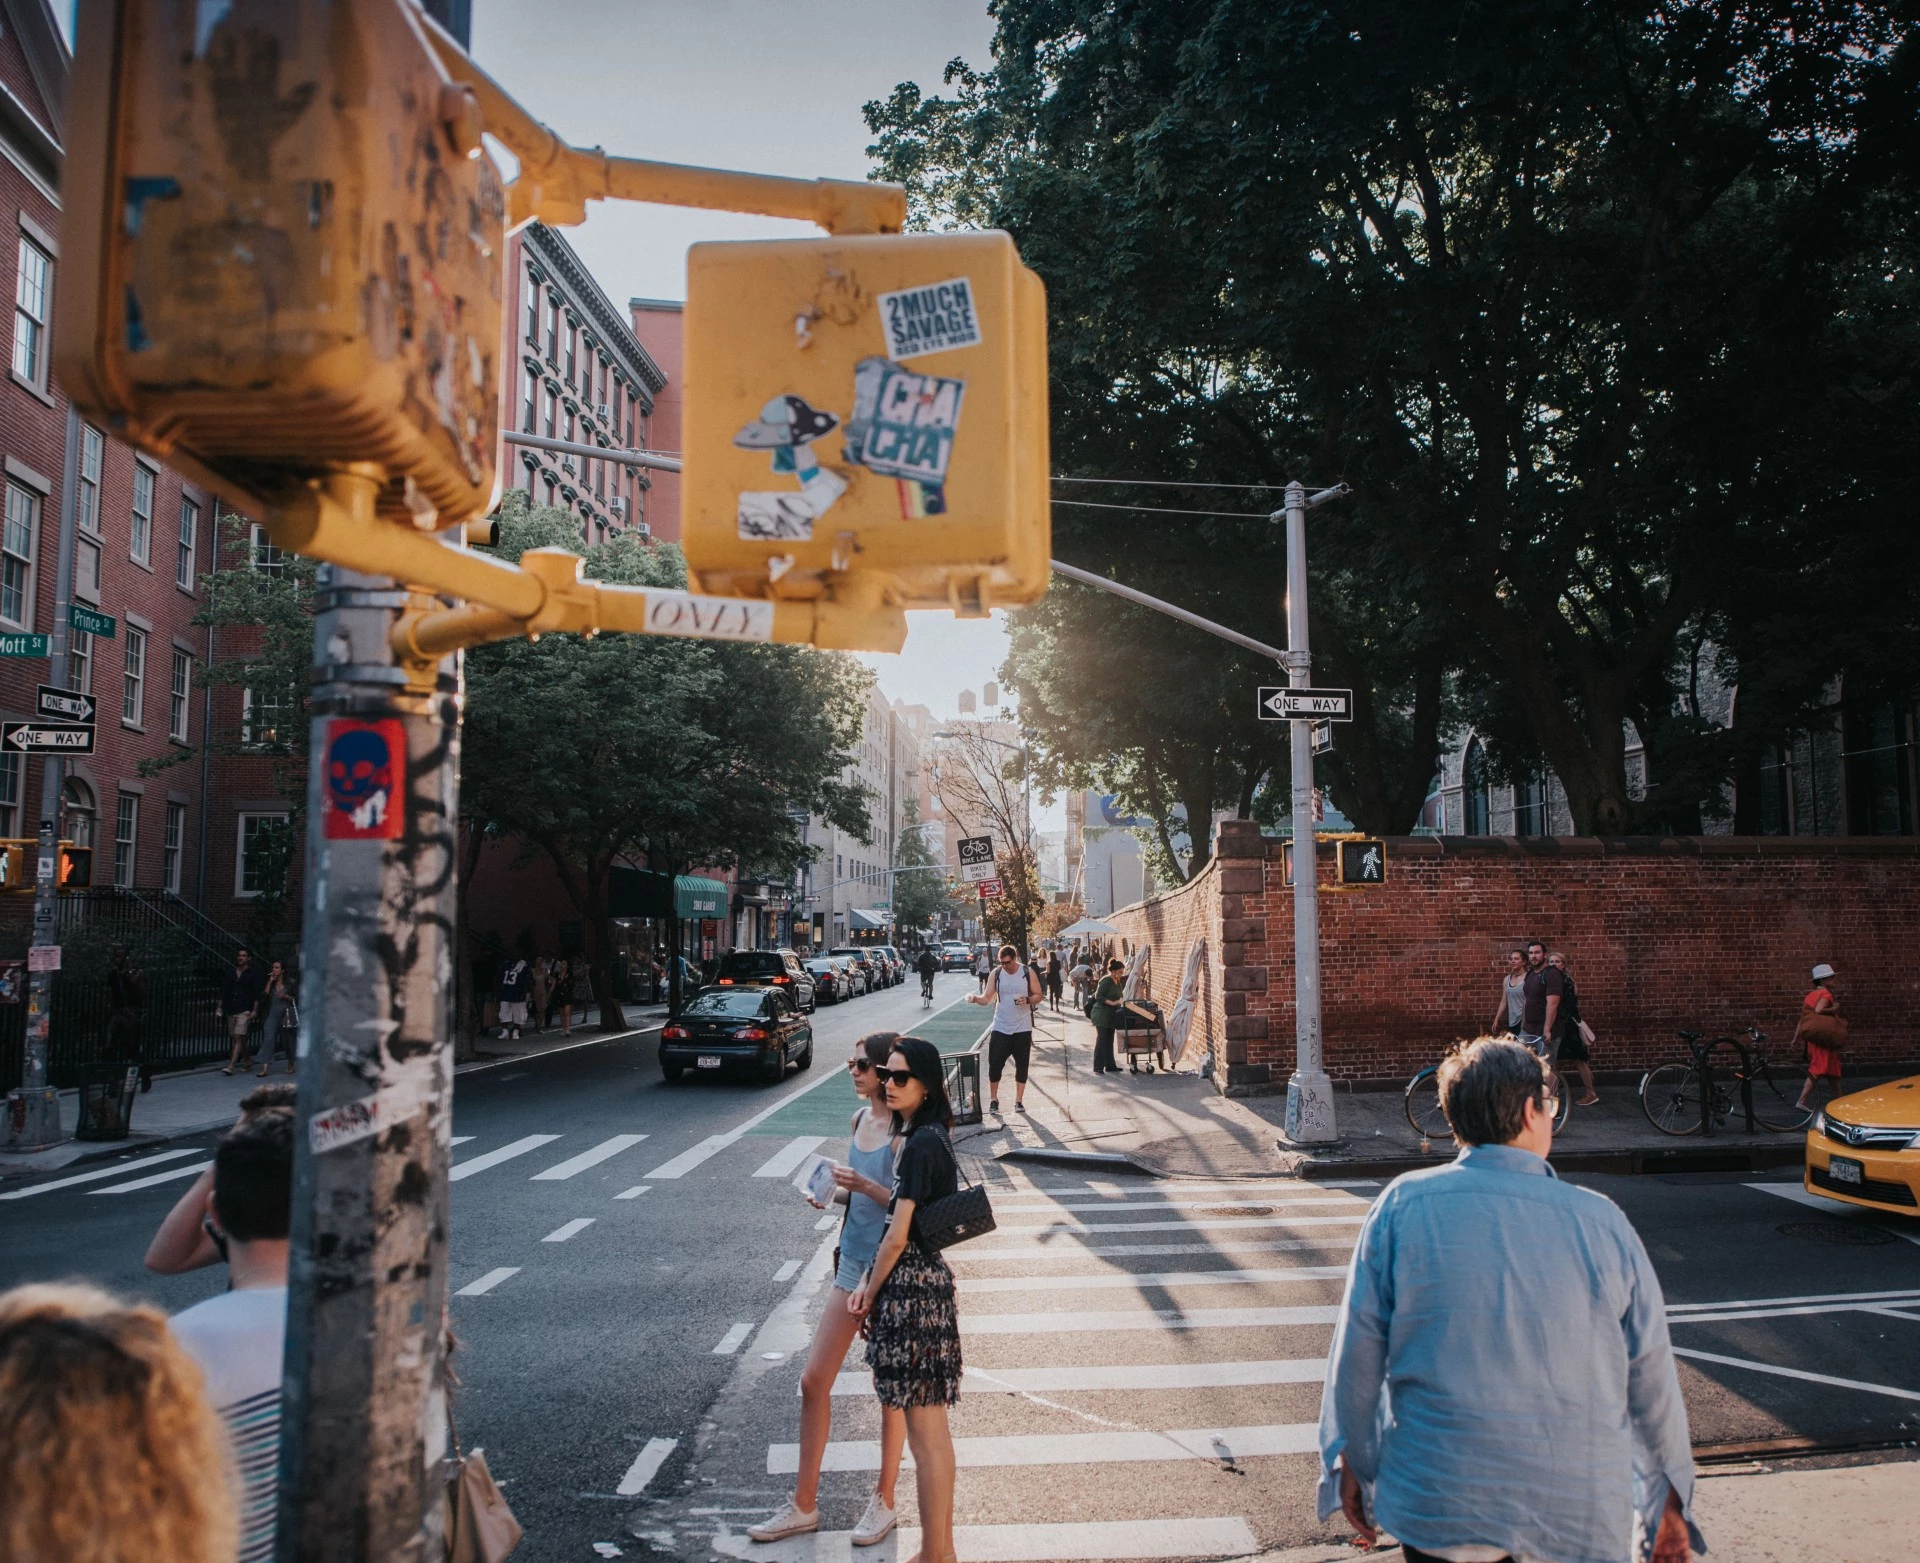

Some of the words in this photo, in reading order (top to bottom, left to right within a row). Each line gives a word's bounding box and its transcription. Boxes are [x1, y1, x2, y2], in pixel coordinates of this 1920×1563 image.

[886, 282, 968, 321] 2MUCH
[892, 309, 974, 344] SAVAGE
[880, 373, 956, 428] CHA
[868, 421, 941, 470] CHA
[74, 610, 101, 632] Prince
[103, 617, 111, 629] St
[32, 637, 42, 648] St
[46, 696, 63, 710] ONE
[70, 701, 89, 715] WAY
[1274, 698, 1300, 710] ONE
[1312, 698, 1340, 711] WAY
[16, 731, 42, 744] ONE
[55, 732, 83, 745] WAY
[962, 856, 975, 864] BIKE
[976, 854, 992, 862] LANE
[503, 970, 518, 985] 13
